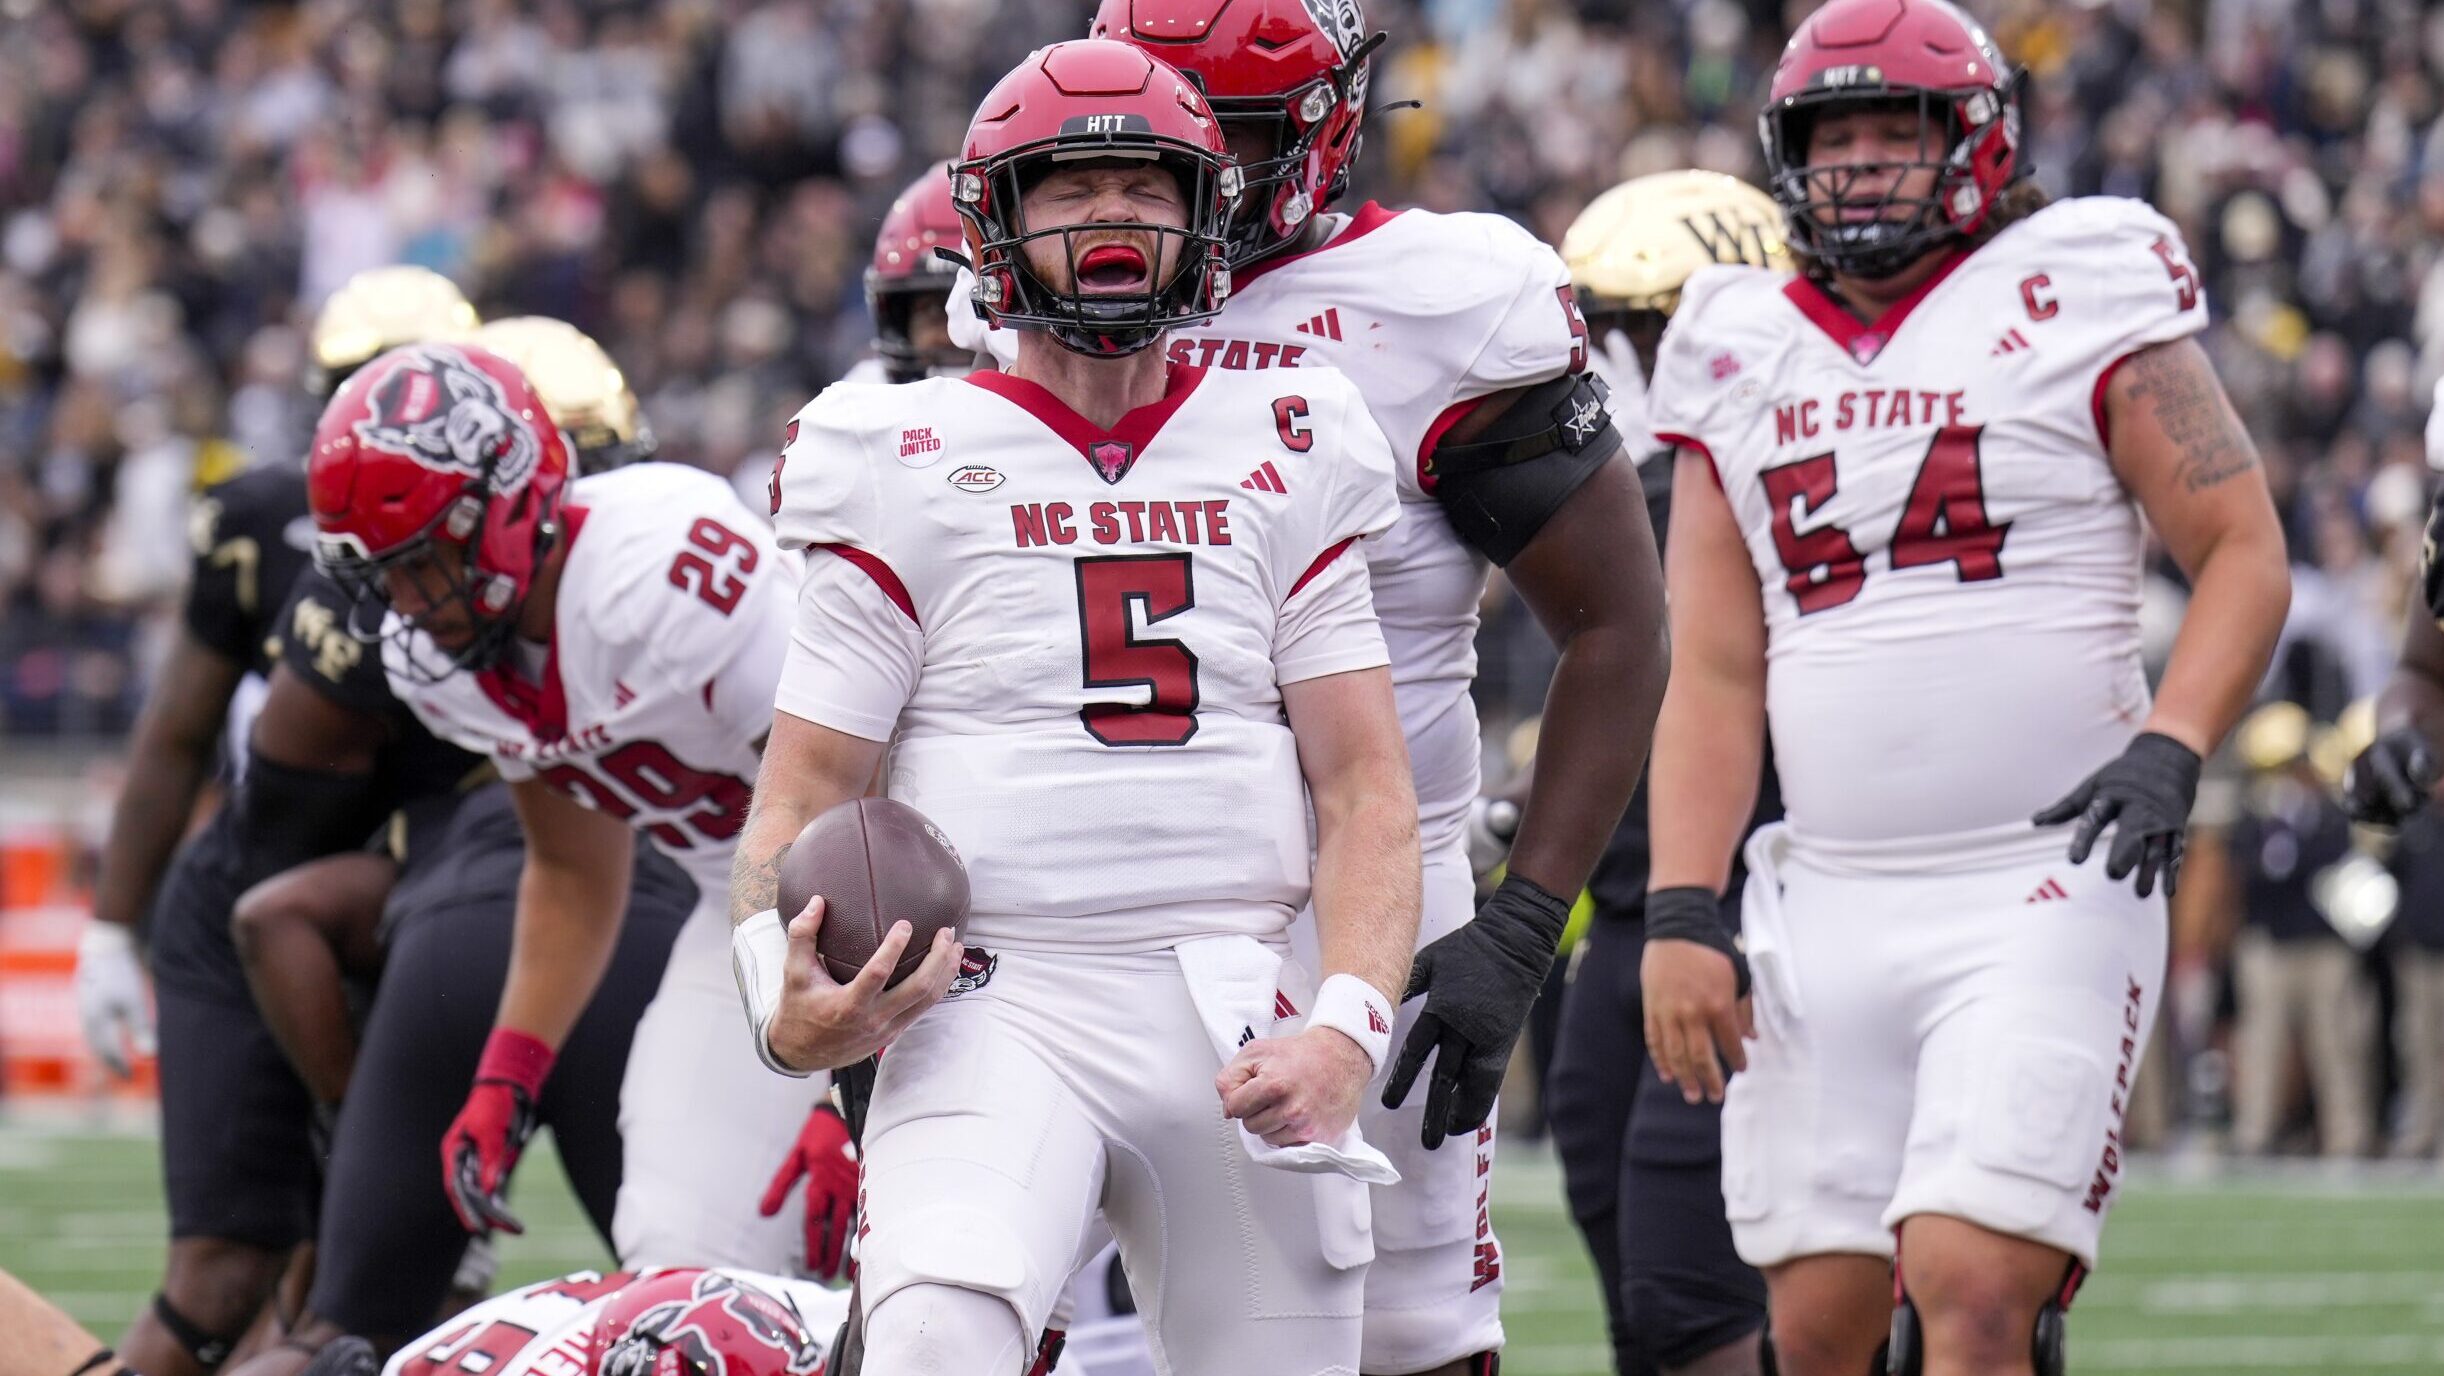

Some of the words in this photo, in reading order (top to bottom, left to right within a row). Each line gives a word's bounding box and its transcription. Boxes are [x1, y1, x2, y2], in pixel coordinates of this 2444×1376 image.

[1087, 115, 1125, 133] HTT
[2021, 274, 2059, 321] C
[902, 427, 932, 443] PACK
[1271, 395, 1314, 453] C
[1776, 399, 1820, 446] NC
[1836, 389, 1965, 430] STATE
[900, 438, 941, 457] UNITED
[956, 471, 998, 483] ACC
[1010, 502, 1078, 547] NC
[1089, 499, 1231, 545] STATE
[1759, 425, 2014, 617] 54
[669, 516, 758, 617] 29
[1074, 551, 1200, 748] 5
[2083, 974, 2142, 1215] WOLFPACK
